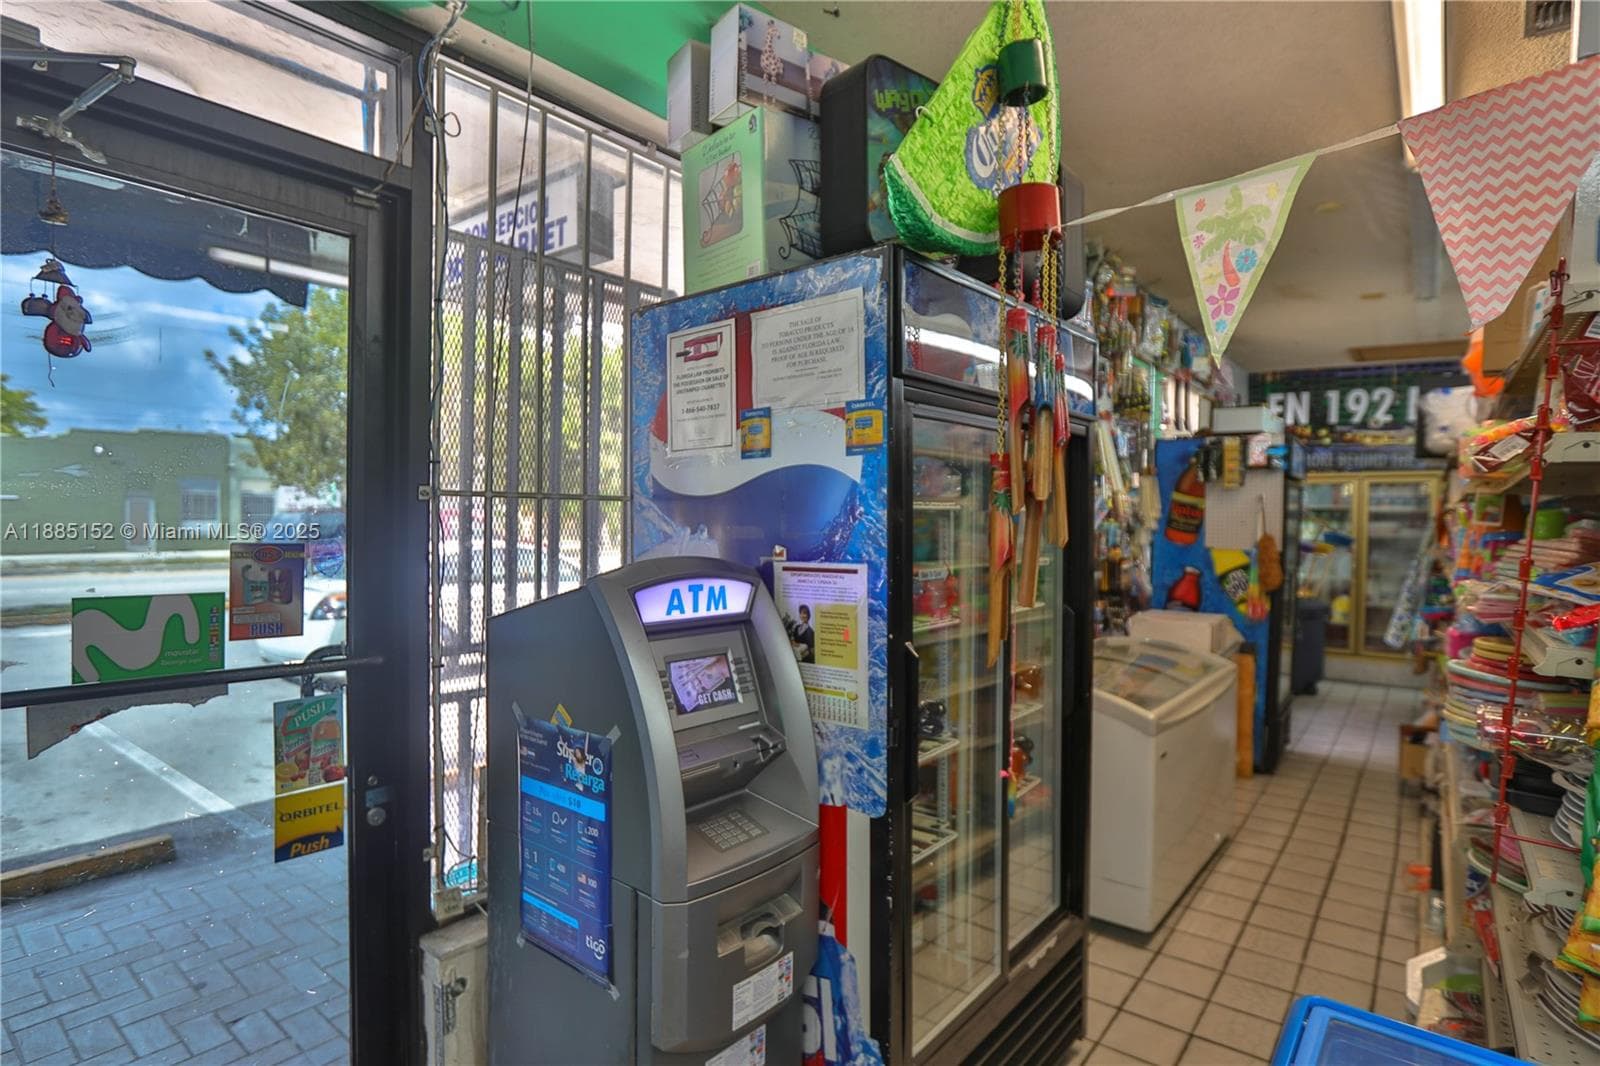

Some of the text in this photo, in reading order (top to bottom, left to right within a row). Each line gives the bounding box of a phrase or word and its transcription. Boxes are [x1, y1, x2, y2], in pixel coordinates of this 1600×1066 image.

[464, 197, 549, 239] CONEPCION
[769, 339, 792, 348] PERSONS
[793, 333, 811, 342] UNDER
[778, 322, 834, 338] TOBACCO PRODUCTS
[779, 344, 802, 353] AGAINST
[802, 341, 826, 350] FLORIDA
[1268, 391, 1310, 425] EN
[1325, 387, 1396, 425] 192
[666, 584, 728, 616] ATM
[251, 623, 284, 636] PUSH
[697, 694, 712, 705] GET
[294, 700, 327, 727] PUSH
[280, 802, 340, 822] ORBITEL
[290, 835, 330, 858] Push
[586, 935, 606, 960] tigo
